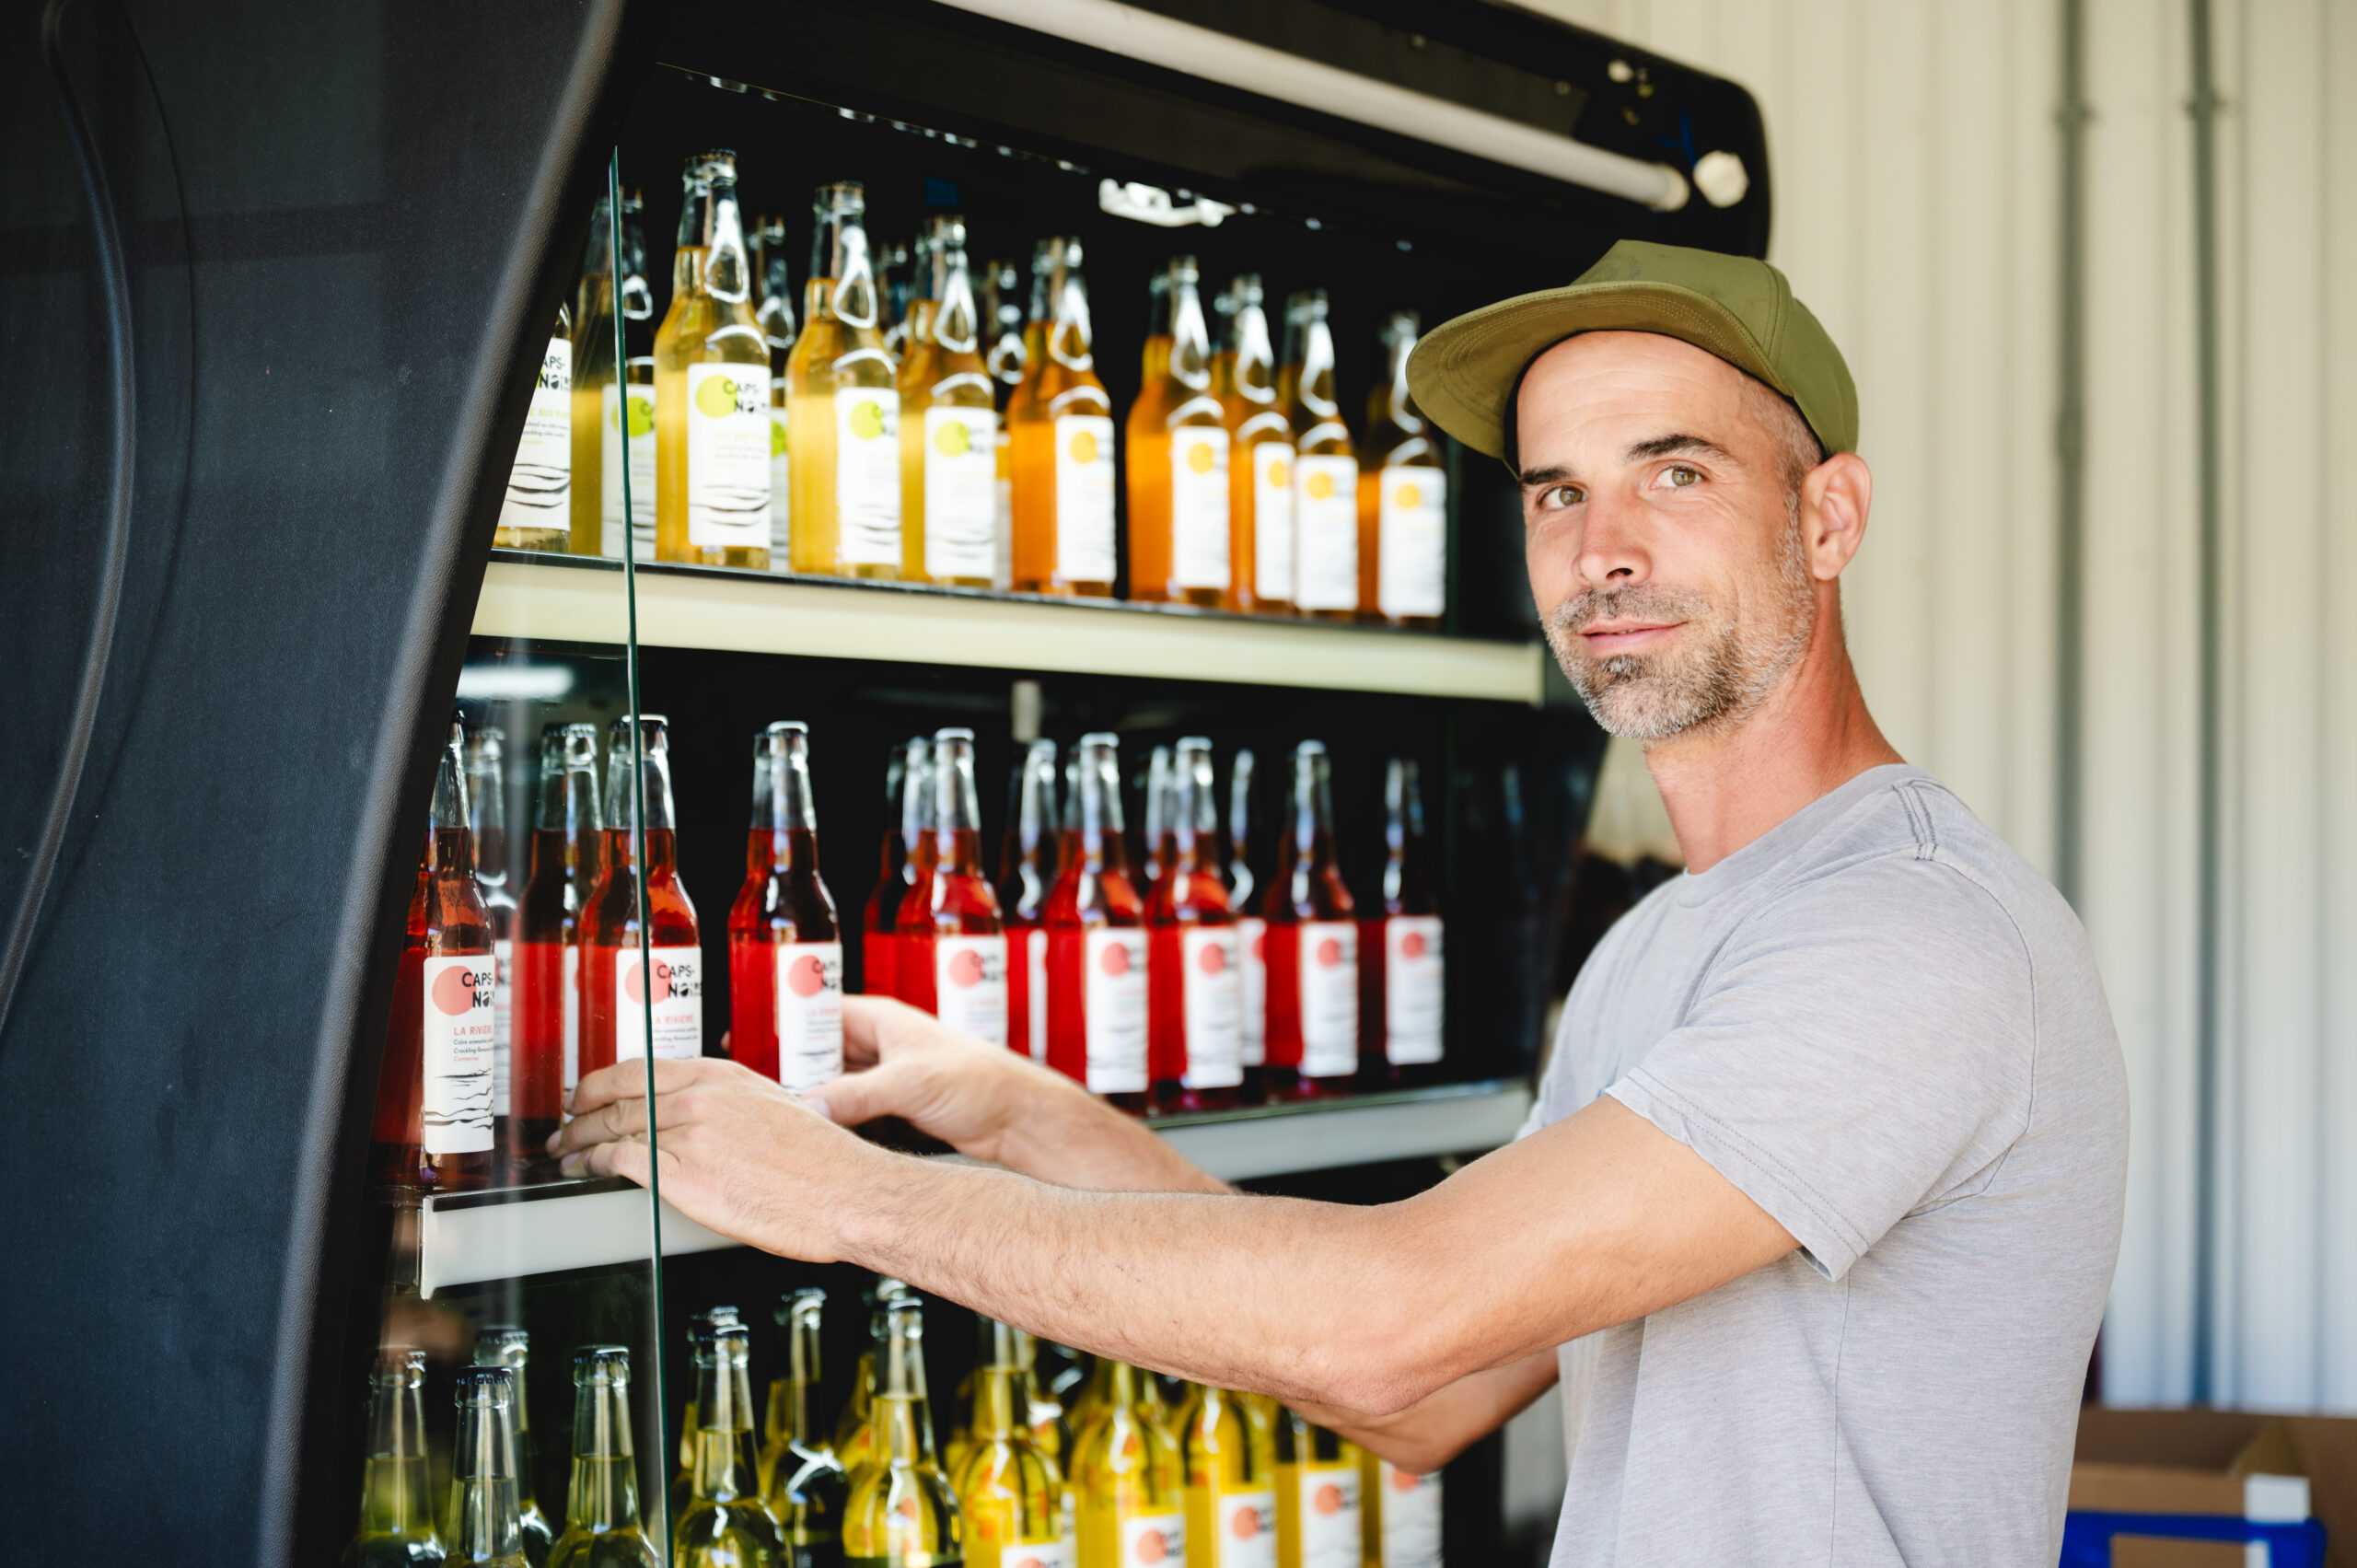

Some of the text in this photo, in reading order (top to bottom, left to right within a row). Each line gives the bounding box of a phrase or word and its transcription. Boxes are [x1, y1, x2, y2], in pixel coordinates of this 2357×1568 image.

[656, 964, 696, 979] CAPS-
[461, 971, 493, 988] CAPS-
[453, 1026, 466, 1036] LA
